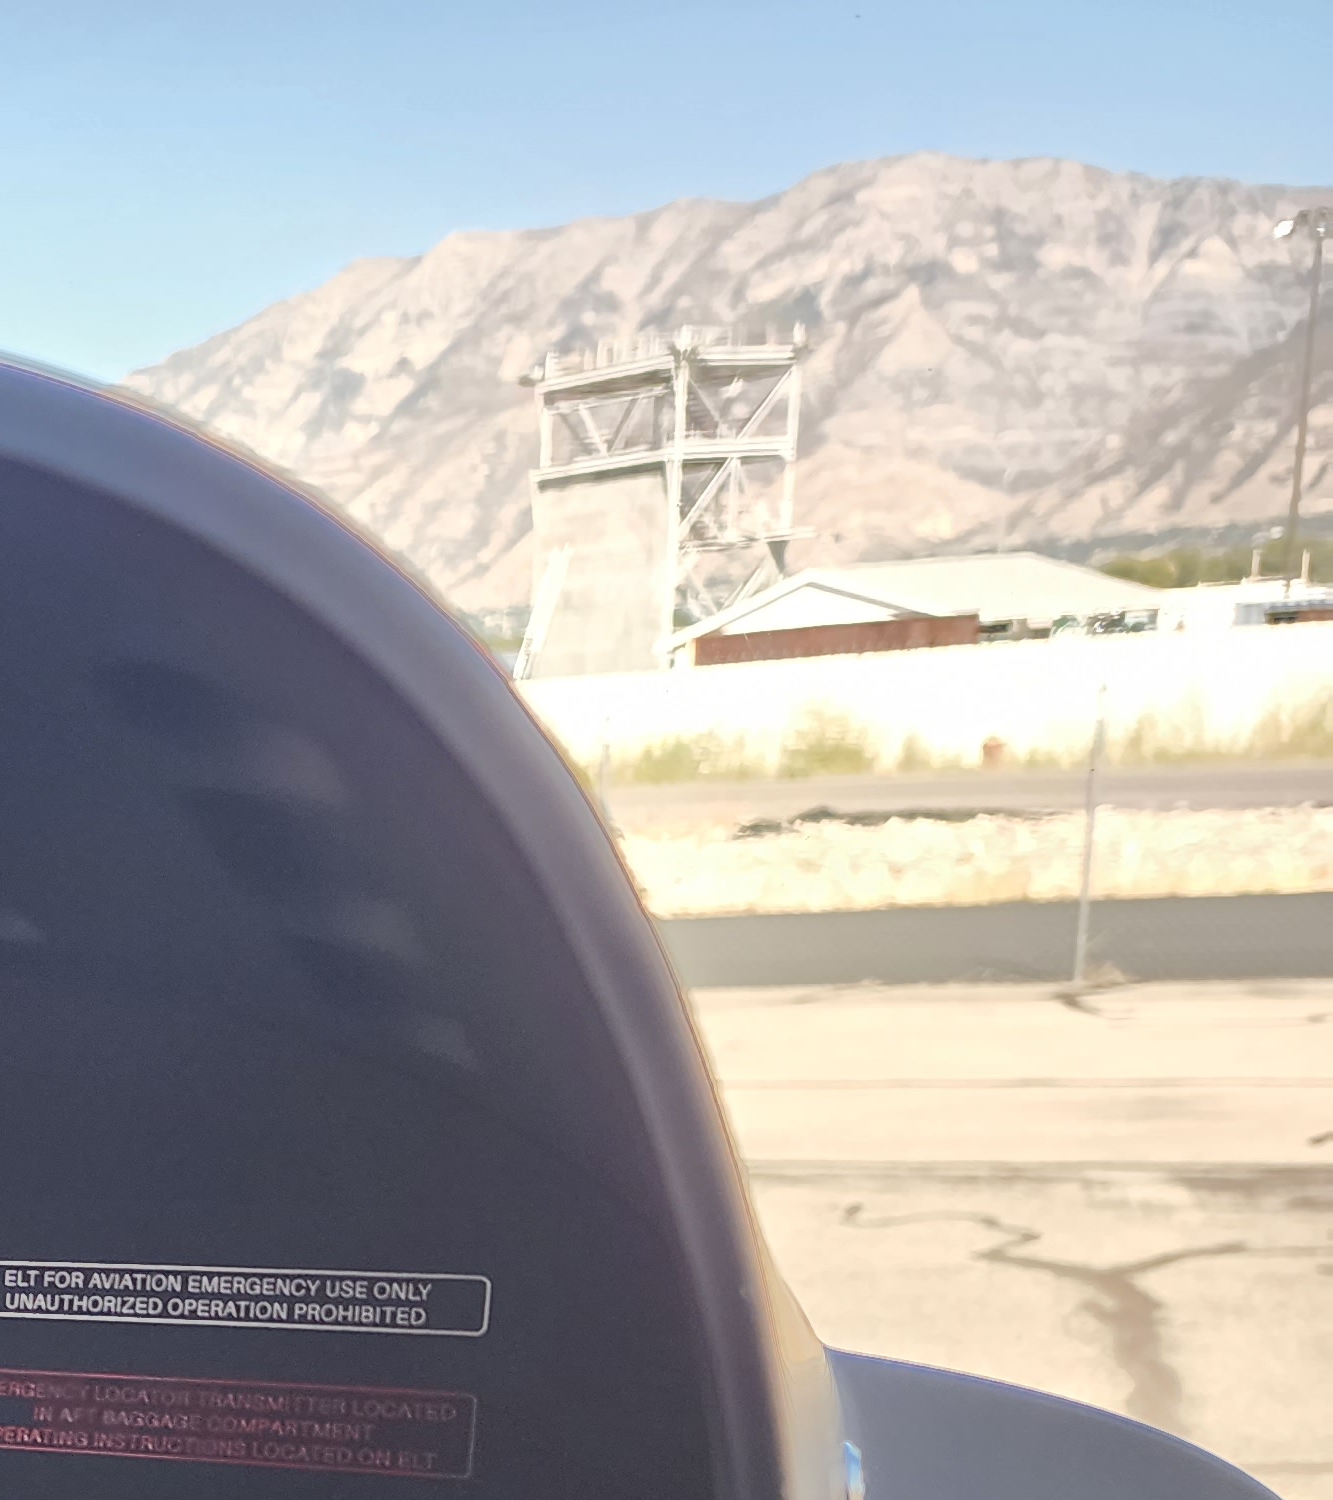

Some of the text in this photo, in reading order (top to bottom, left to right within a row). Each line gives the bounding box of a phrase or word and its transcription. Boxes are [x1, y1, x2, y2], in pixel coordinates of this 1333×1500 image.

[4, 1270, 432, 1301] ELT FOR AVIATION EMERGENCY USE ONLY
[5, 1293, 427, 1325] UNAUTHORIZED OPERATION PROHIBITED
